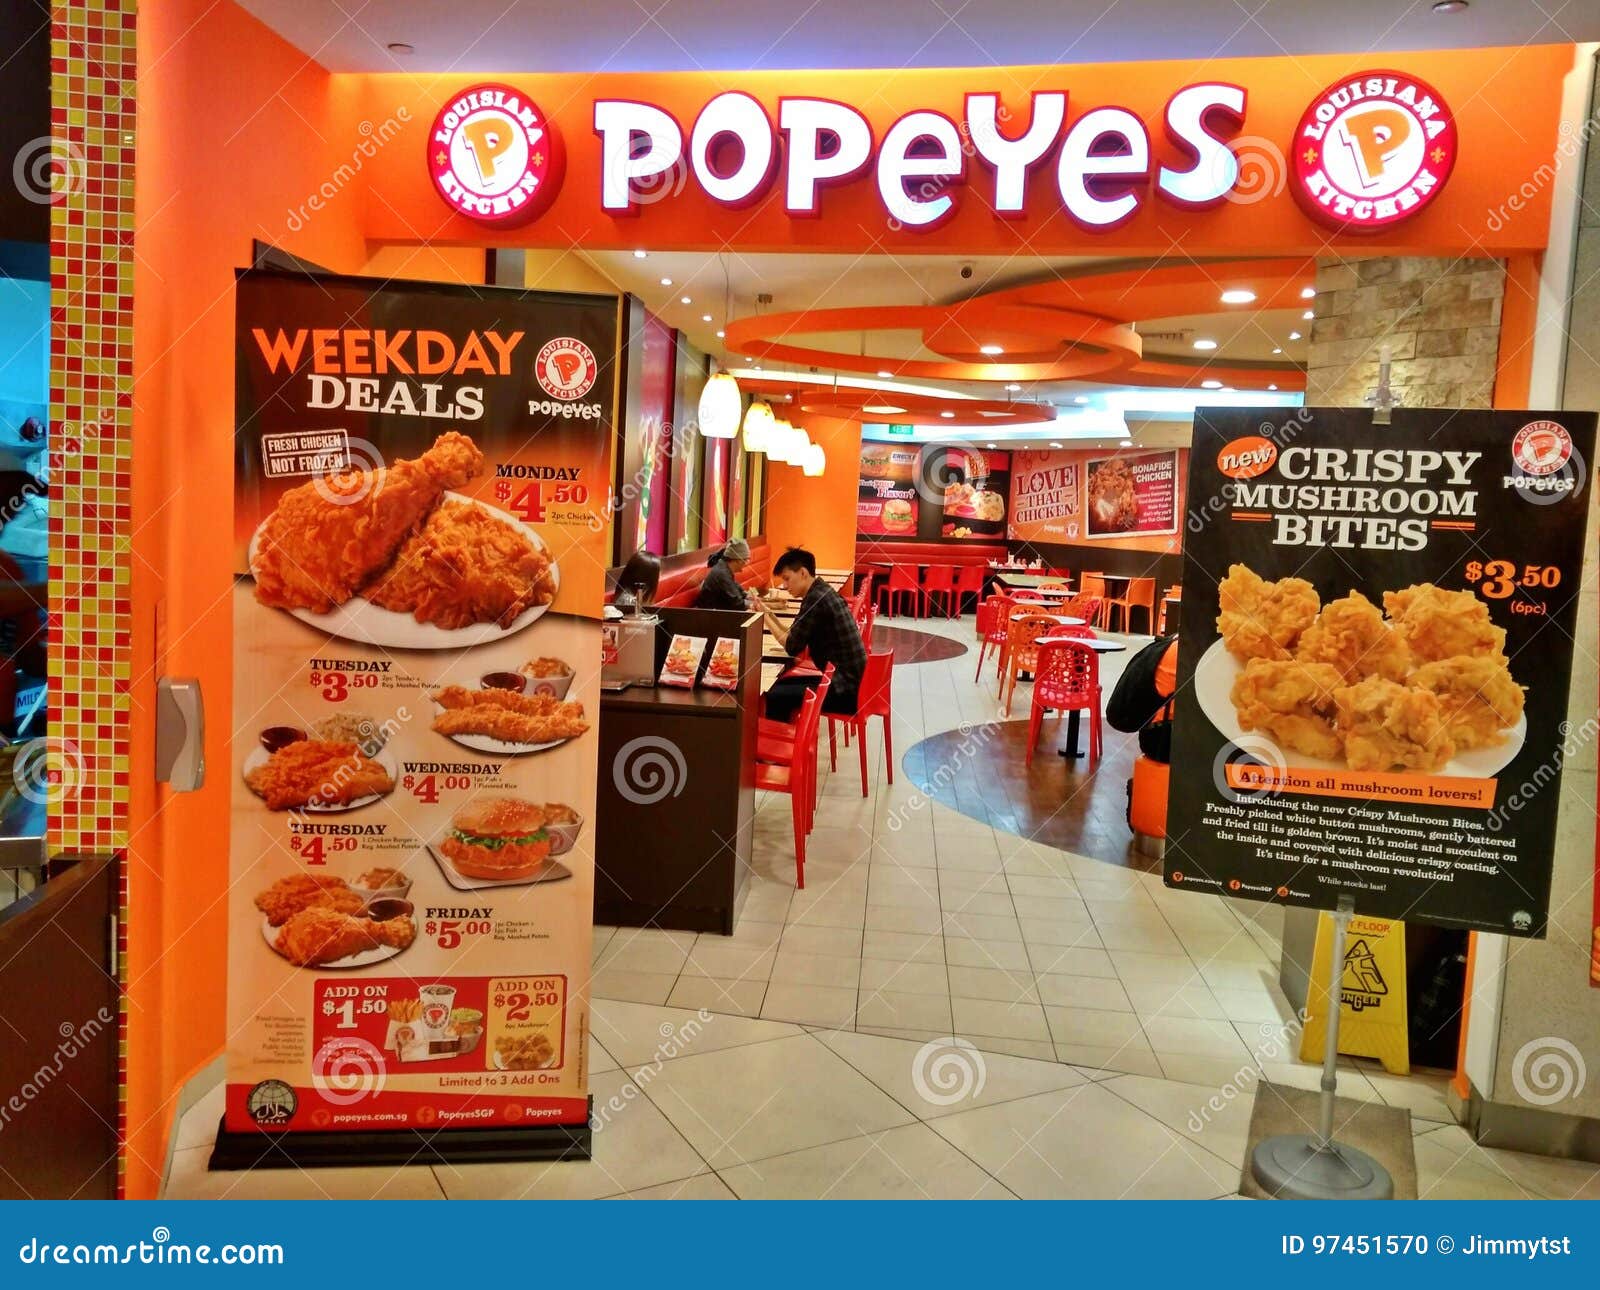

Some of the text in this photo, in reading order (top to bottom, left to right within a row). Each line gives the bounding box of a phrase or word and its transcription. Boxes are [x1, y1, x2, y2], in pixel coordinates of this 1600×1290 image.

[435, 89, 545, 147] LOUISIANA
[1304, 78, 1449, 141] LOUISIANA
[463, 117, 513, 187] P
[1342, 107, 1410, 188] P
[438, 169, 541, 215] KITCHEN
[1305, 169, 1438, 219] KITCHEN
[252, 327, 525, 375] WEEKDAY
[538, 340, 593, 366] LOUISIANA
[306, 374, 485, 421] DEALS
[540, 376, 591, 398] KITCHEN
[268, 434, 341, 452] FRESH CHICKEN
[1516, 422, 1569, 445] LOUISIANA
[271, 453, 344, 473] NOT FROZEN
[496, 464, 581, 480] MONDAY
[1132, 461, 1172, 474] BONAFIDE
[1221, 447, 1272, 471] new
[1278, 446, 1482, 485] CRISPY
[1516, 455, 1566, 473] KITCHEN
[1016, 465, 1073, 495] LOVE
[1136, 470, 1172, 483] CHICKEN
[495, 480, 590, 523] $4.50
[1026, 490, 1063, 507] THAT
[1232, 484, 1478, 517] MUSHROOM
[551, 511, 565, 520] 2pc
[1272, 514, 1428, 552] BITES
[1464, 560, 1561, 599] $3.50
[1510, 600, 1547, 617] (6pc)
[310, 658, 393, 673] TUESDAY
[309, 672, 379, 702] $3.50
[402, 762, 502, 775] WEDNESDAY
[402, 774, 471, 804] $4.00
[1240, 771, 1483, 801] Attention all mushroom lovers!
[1206, 803, 1516, 848] Freshly picked white button mushrooms, gently battered
[1236, 793, 1485, 831] Introducing the new Crispy Mushroom Bites.
[290, 823, 387, 836] THURSDAY
[1202, 817, 1518, 862] and fried till its golden brown. It's moist and succulent on
[290, 836, 358, 866] $4.50
[1217, 830, 1500, 875] the inside and covered with delicious crispy coating.
[1256, 848, 1273, 859] It's
[1275, 852, 1300, 863] time
[1303, 854, 1320, 865] for
[1332, 859, 1390, 875] mushroom
[1393, 868, 1454, 882] revolution!
[1317, 875, 1387, 891] While stocks last!
[425, 907, 494, 919] FRIDAY
[425, 921, 492, 949] $5.00
[323, 985, 388, 998] ADD ON
[494, 980, 555, 992] ADD ON
[322, 999, 387, 1029] $1.50
[494, 992, 559, 1021] $2.50
[439, 1074, 560, 1087] Limited to 3 Add Ons
[333, 1113, 408, 1124] popeyes.com.sg
[438, 1108, 495, 1120] PopeyesSGP
[526, 1107, 562, 1117] Popeyes
